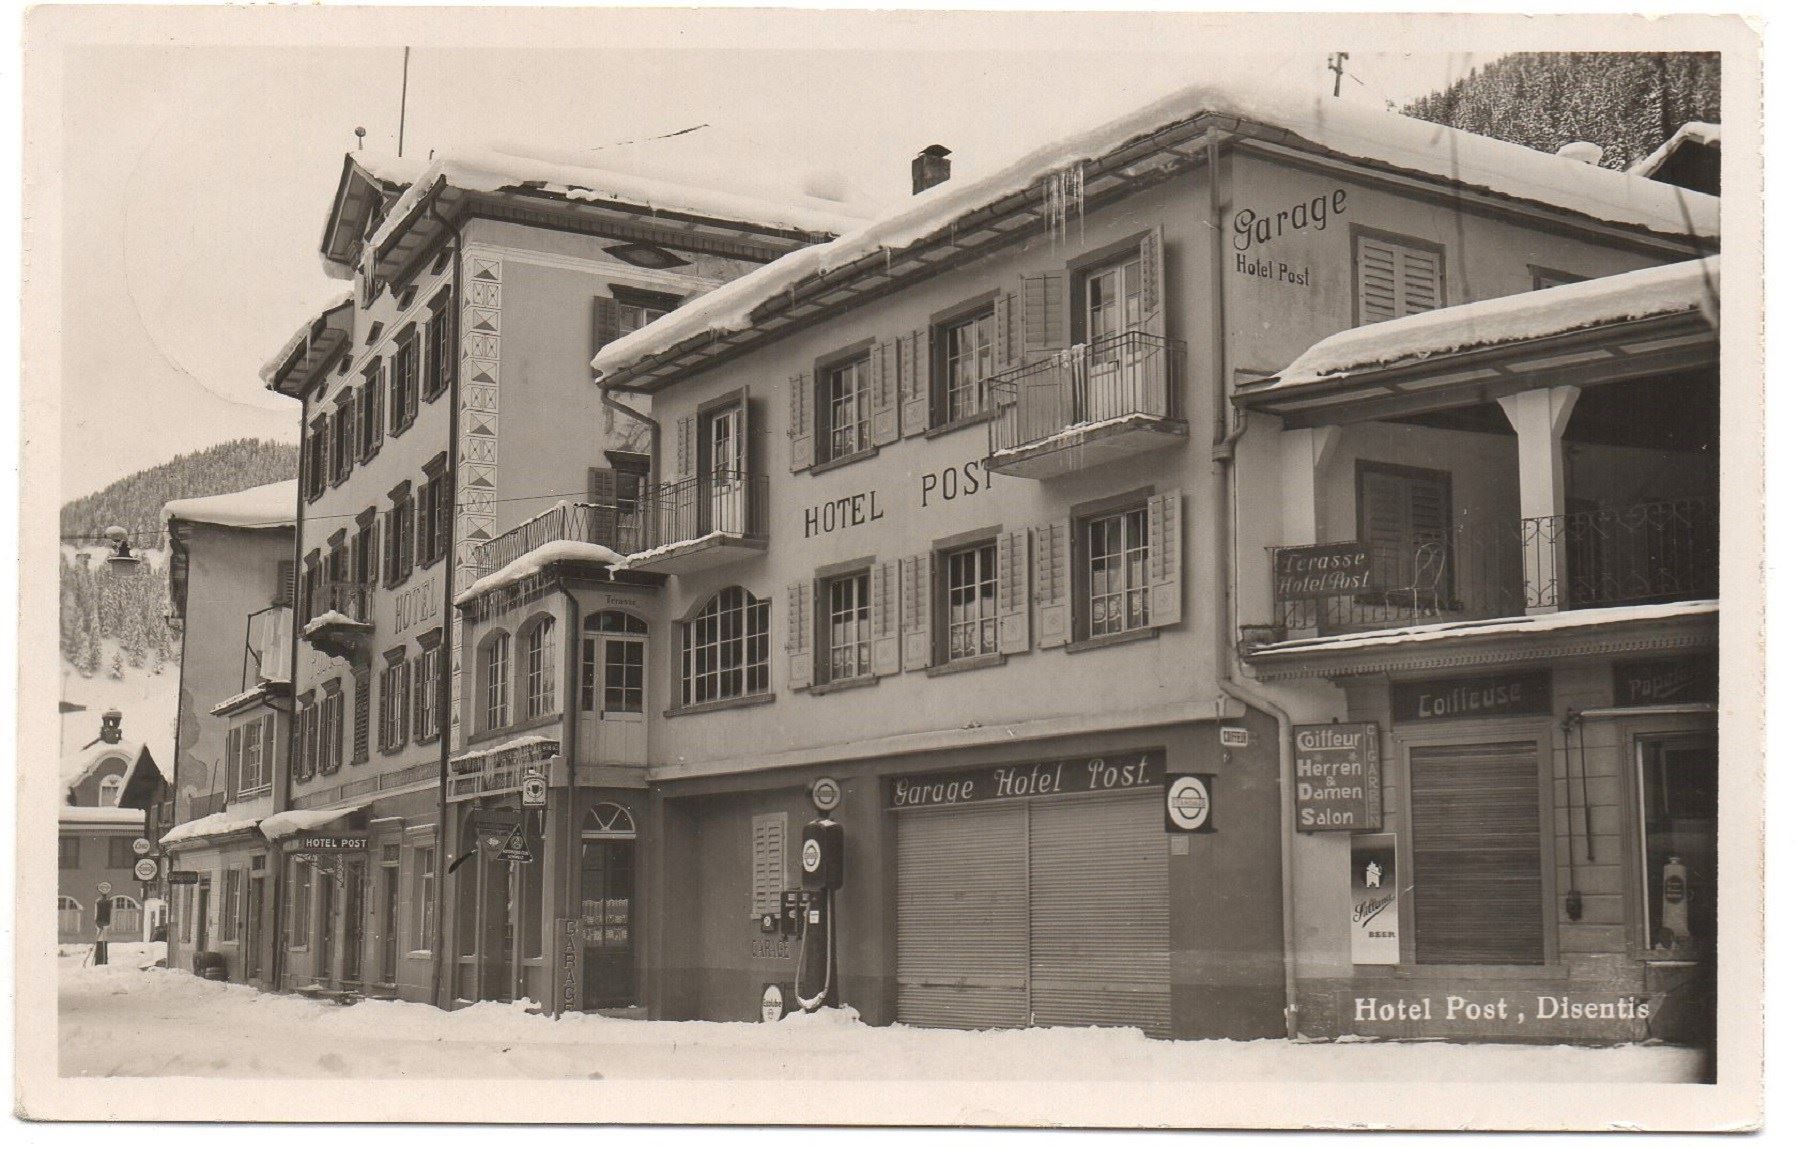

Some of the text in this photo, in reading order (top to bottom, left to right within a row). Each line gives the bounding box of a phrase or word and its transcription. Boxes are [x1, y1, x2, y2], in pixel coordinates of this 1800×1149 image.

[1233, 188, 1347, 251] Garage
[1235, 252, 1309, 286] Hotel Post
[805, 457, 992, 538] HOTEL POST
[1283, 552, 1365, 573] Terasse
[1279, 570, 1370, 594] Hotel Post
[394, 577, 438, 635] HOTEL
[1418, 683, 1521, 718] Coiffeuse
[1296, 729, 1361, 752] Coiffeur
[1296, 758, 1361, 777] Herren
[894, 777, 974, 808] Garage
[993, 763, 1063, 797] Hotel
[1297, 782, 1362, 800] Damen
[1326, 775, 1337, 787] &
[1301, 807, 1354, 826] Salon
[306, 838, 367, 848] HOTEL POST
